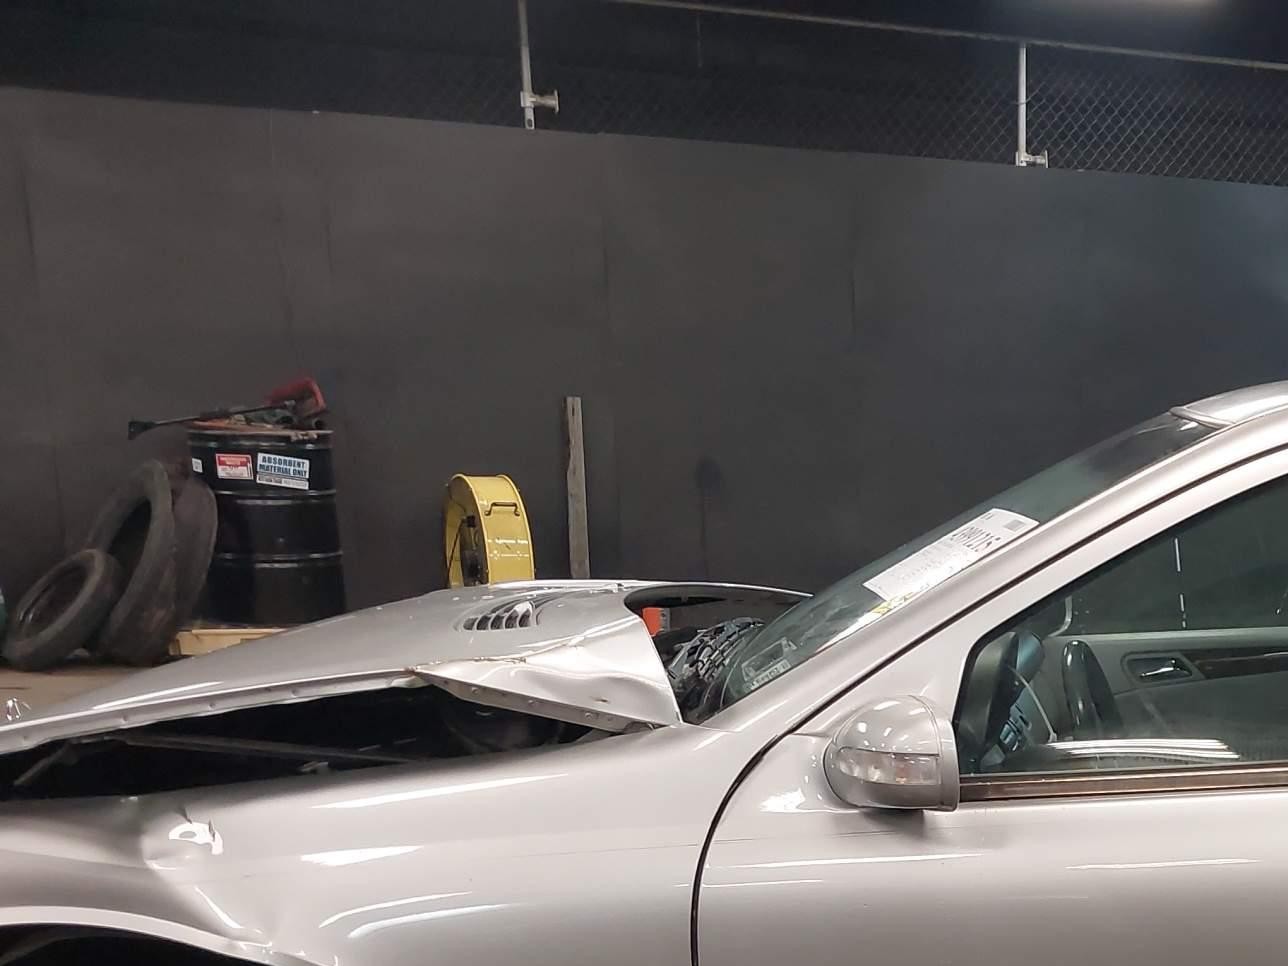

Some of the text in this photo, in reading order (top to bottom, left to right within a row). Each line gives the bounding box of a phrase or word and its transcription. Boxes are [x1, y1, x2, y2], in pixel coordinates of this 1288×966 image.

[261, 455, 306, 468] ABSORBENT
[259, 463, 291, 476] MATERIAL
[292, 468, 308, 477] ONLY
